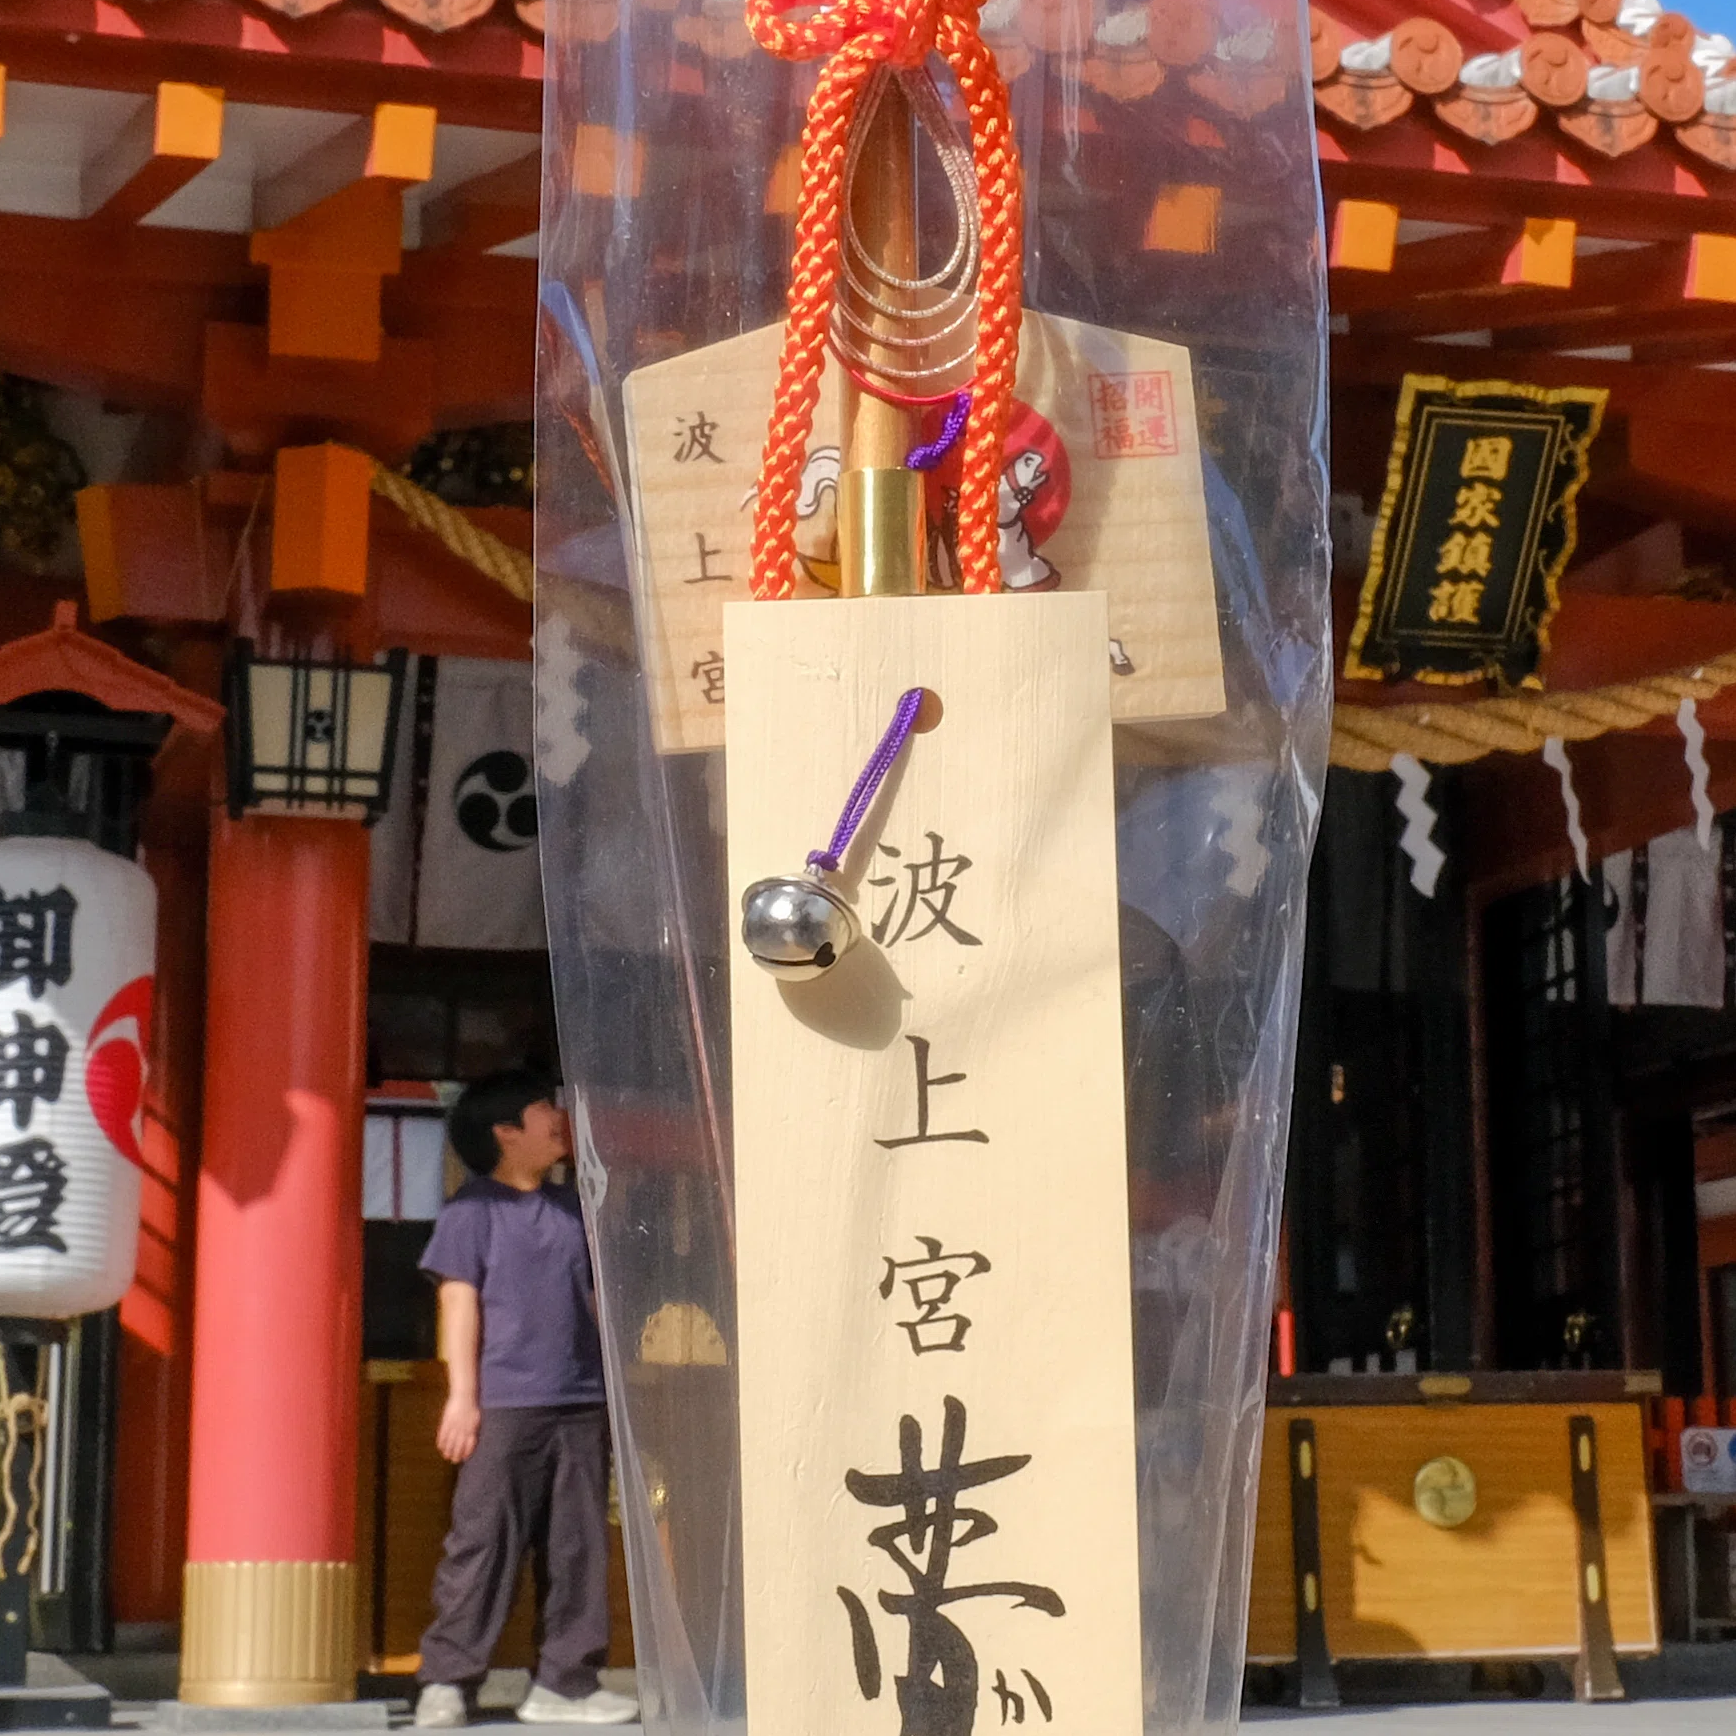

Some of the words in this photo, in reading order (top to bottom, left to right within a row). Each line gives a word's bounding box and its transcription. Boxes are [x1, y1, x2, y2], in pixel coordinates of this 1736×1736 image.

[673, 410, 733, 705] 波上宮
[868, 831, 991, 1357] 波上宮
